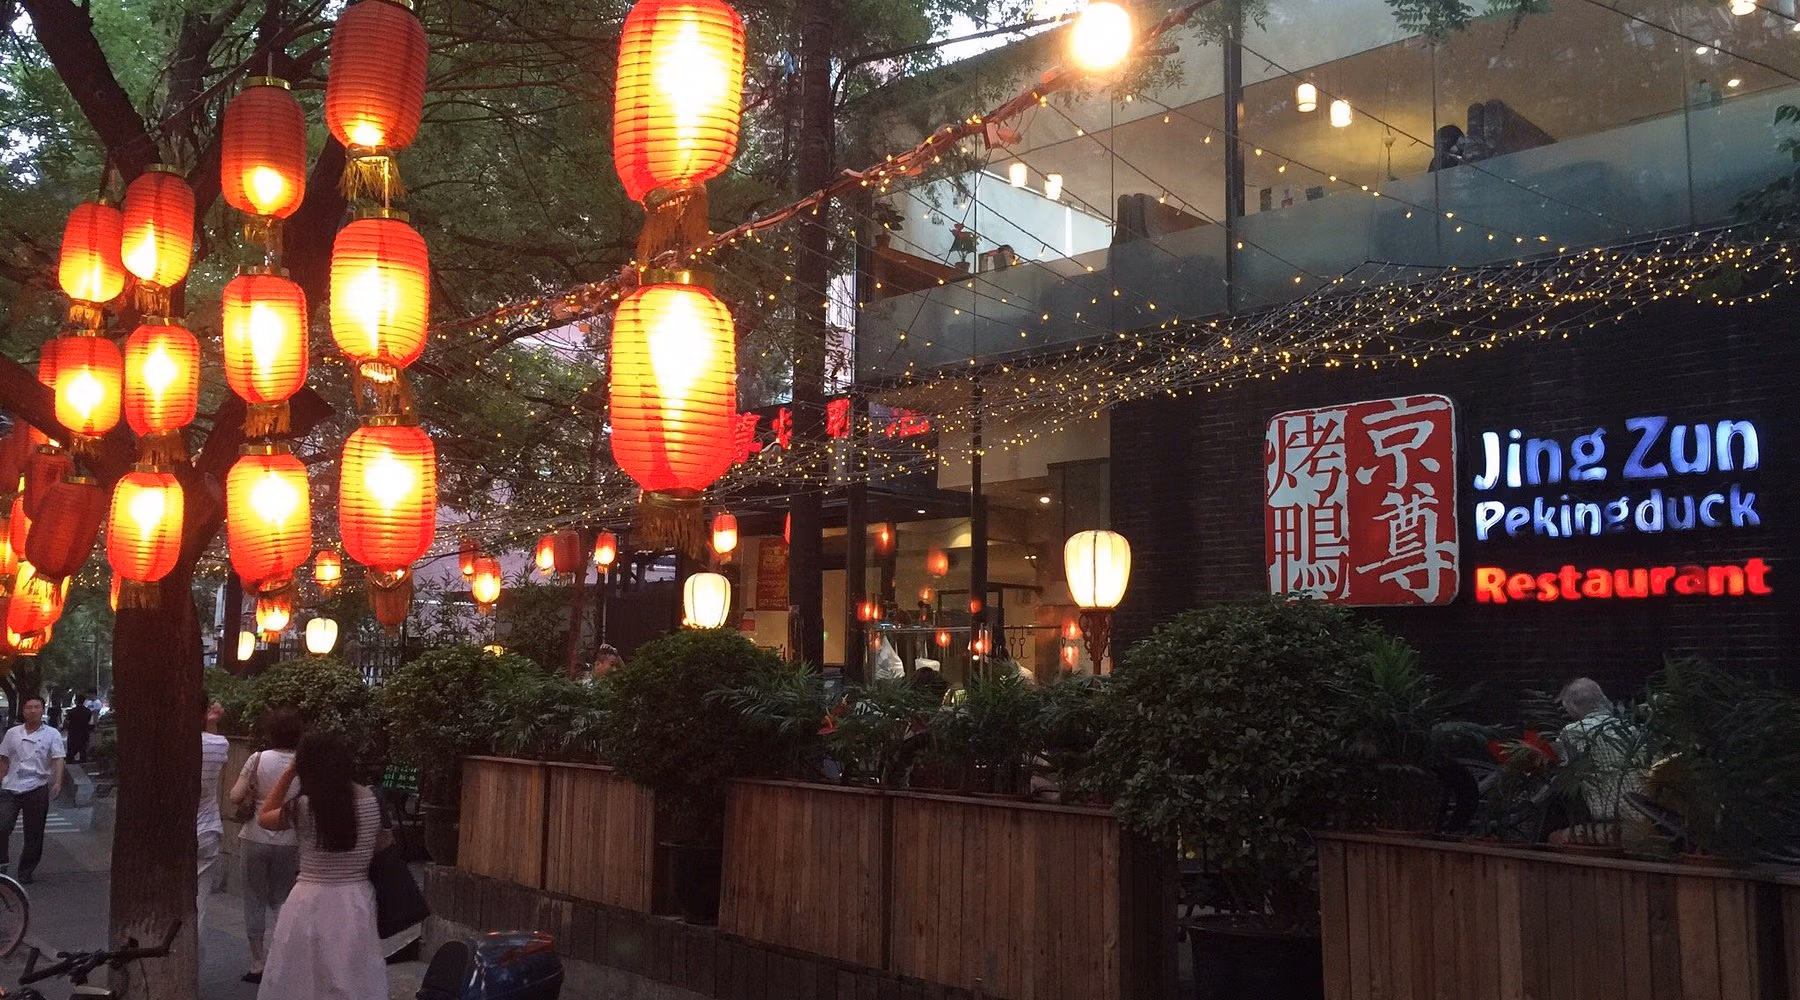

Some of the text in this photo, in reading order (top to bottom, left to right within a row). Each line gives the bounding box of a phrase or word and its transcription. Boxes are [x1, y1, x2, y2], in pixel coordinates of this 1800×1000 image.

[1473, 414, 1761, 491] Jing Zun
[1265, 414, 1349, 601] 烤鴨
[1355, 398, 1457, 604] 京尊
[1474, 484, 1761, 541] Pekingduck
[1474, 557, 1773, 604] Restaurant
